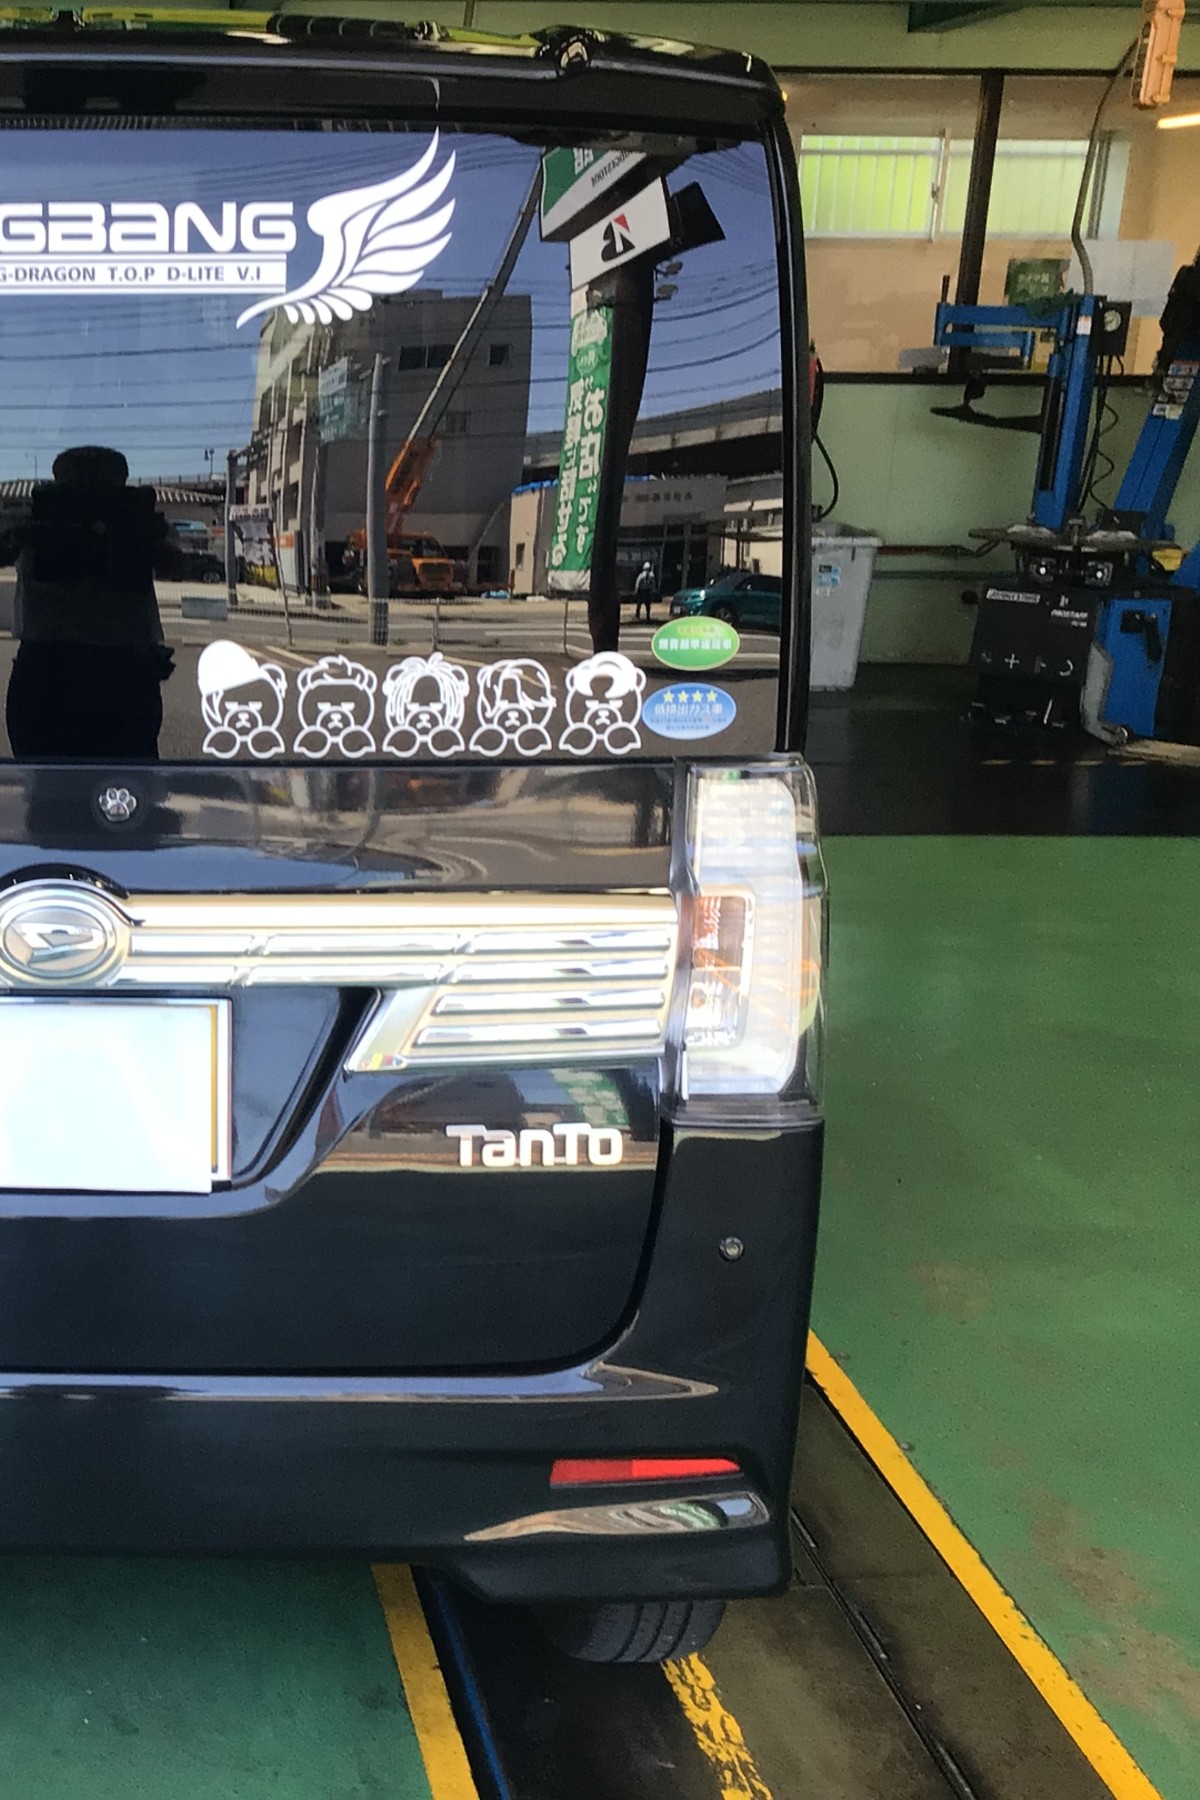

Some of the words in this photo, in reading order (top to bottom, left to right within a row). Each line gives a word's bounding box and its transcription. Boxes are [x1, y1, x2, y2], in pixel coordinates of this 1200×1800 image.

[108, 266, 155, 283] T.O.P
[167, 266, 224, 283] D-LITE
[237, 266, 261, 282] V.I
